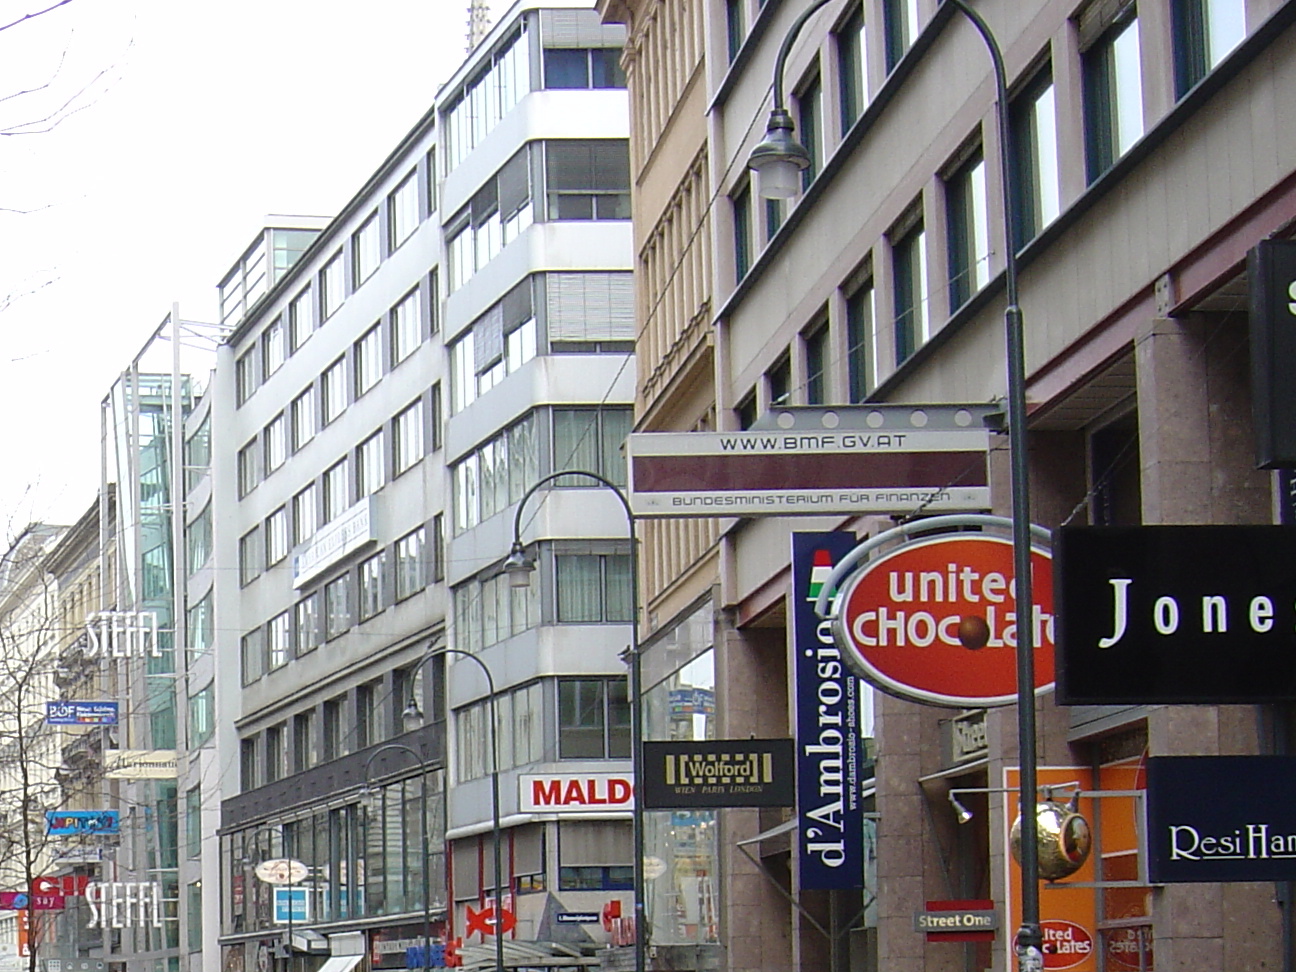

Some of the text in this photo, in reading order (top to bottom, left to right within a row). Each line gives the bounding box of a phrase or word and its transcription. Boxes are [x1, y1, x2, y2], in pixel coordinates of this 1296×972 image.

[720, 434, 907, 451] WWW.BMF.GV.AT
[672, 491, 951, 507] BUNDESMINISTERIUM FÜR FINANZEN
[1098, 578, 1296, 649] Jone
[85, 611, 163, 658] STEFFL
[688, 760, 751, 777] Wolford
[532, 779, 634, 807] MALD
[674, 784, 764, 795] WIEN PARIS LONDON
[1168, 825, 1241, 860] Resi
[85, 881, 163, 928] STEFFL
[919, 914, 992, 928] Street One
[1042, 927, 1073, 940] ited
